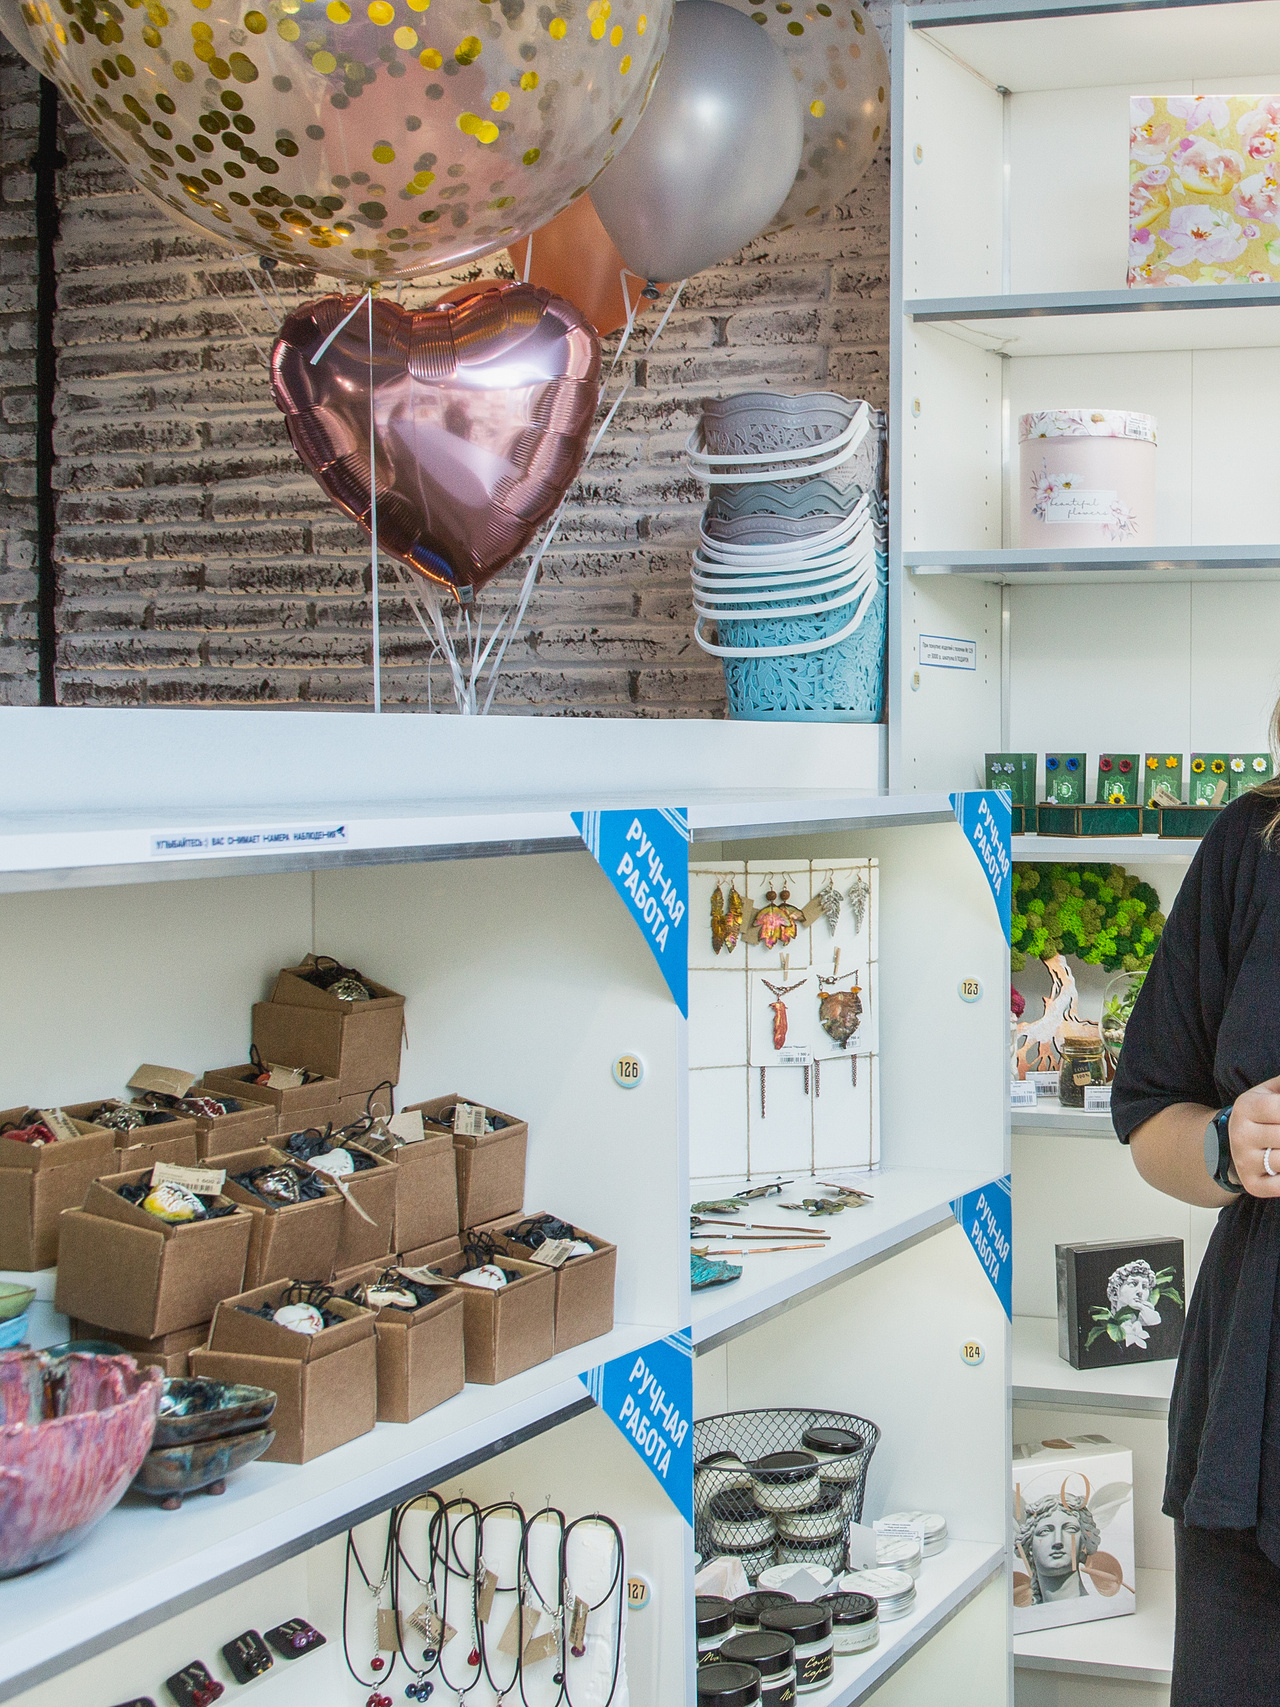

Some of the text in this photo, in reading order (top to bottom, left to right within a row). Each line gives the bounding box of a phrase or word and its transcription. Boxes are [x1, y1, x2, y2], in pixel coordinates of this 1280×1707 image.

[1049, 498, 1100, 508] beautiful
[1067, 508, 1110, 519] flowers
[211, 836, 225, 846] ВАС
[973, 822, 1003, 897] РАБОТА
[978, 797, 1010, 879] РУЧНАЯ
[616, 851, 670, 953] РАБОТА
[625, 817, 686, 929] РУЧНАЯ
[962, 982, 979, 996] 123
[618, 1061, 639, 1078] 126
[971, 1221, 1000, 1285] РАБОТА
[975, 1192, 1010, 1263] РУЧНАЯ
[964, 1345, 981, 1359] 124
[628, 1356, 689, 1449] РУЧНАЯ
[618, 1393, 672, 1479] РАБОТА
[627, 1582, 646, 1600] 127
